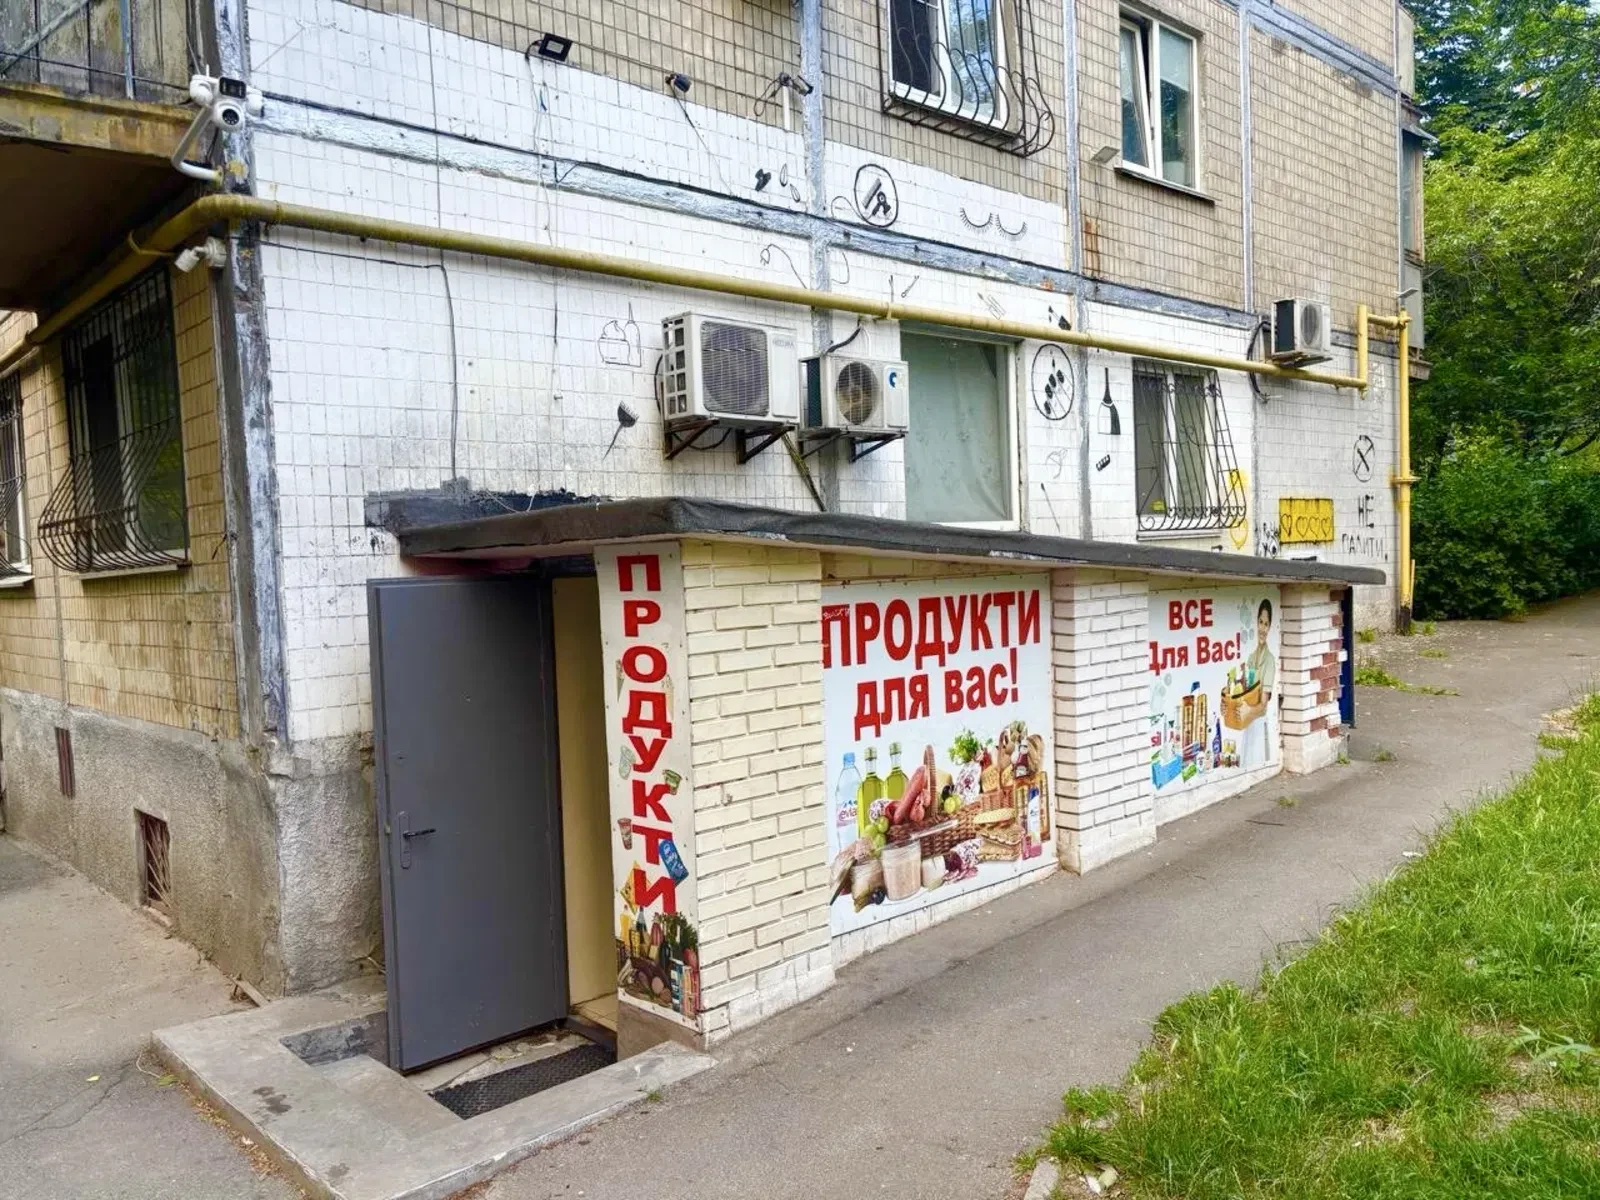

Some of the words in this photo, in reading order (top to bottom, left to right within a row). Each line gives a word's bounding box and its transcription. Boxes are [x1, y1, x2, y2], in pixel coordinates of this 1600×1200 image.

[1358, 494, 1375, 529] НЕ
[821, 590, 1041, 670] ПРОДУКТИ
[1169, 599, 1213, 630] ВСЕ
[1197, 632, 1241, 665] Вас!
[854, 674, 930, 741] для
[944, 648, 1019, 714] вас!
[617, 554, 676, 915] ПРОДУКТИ
